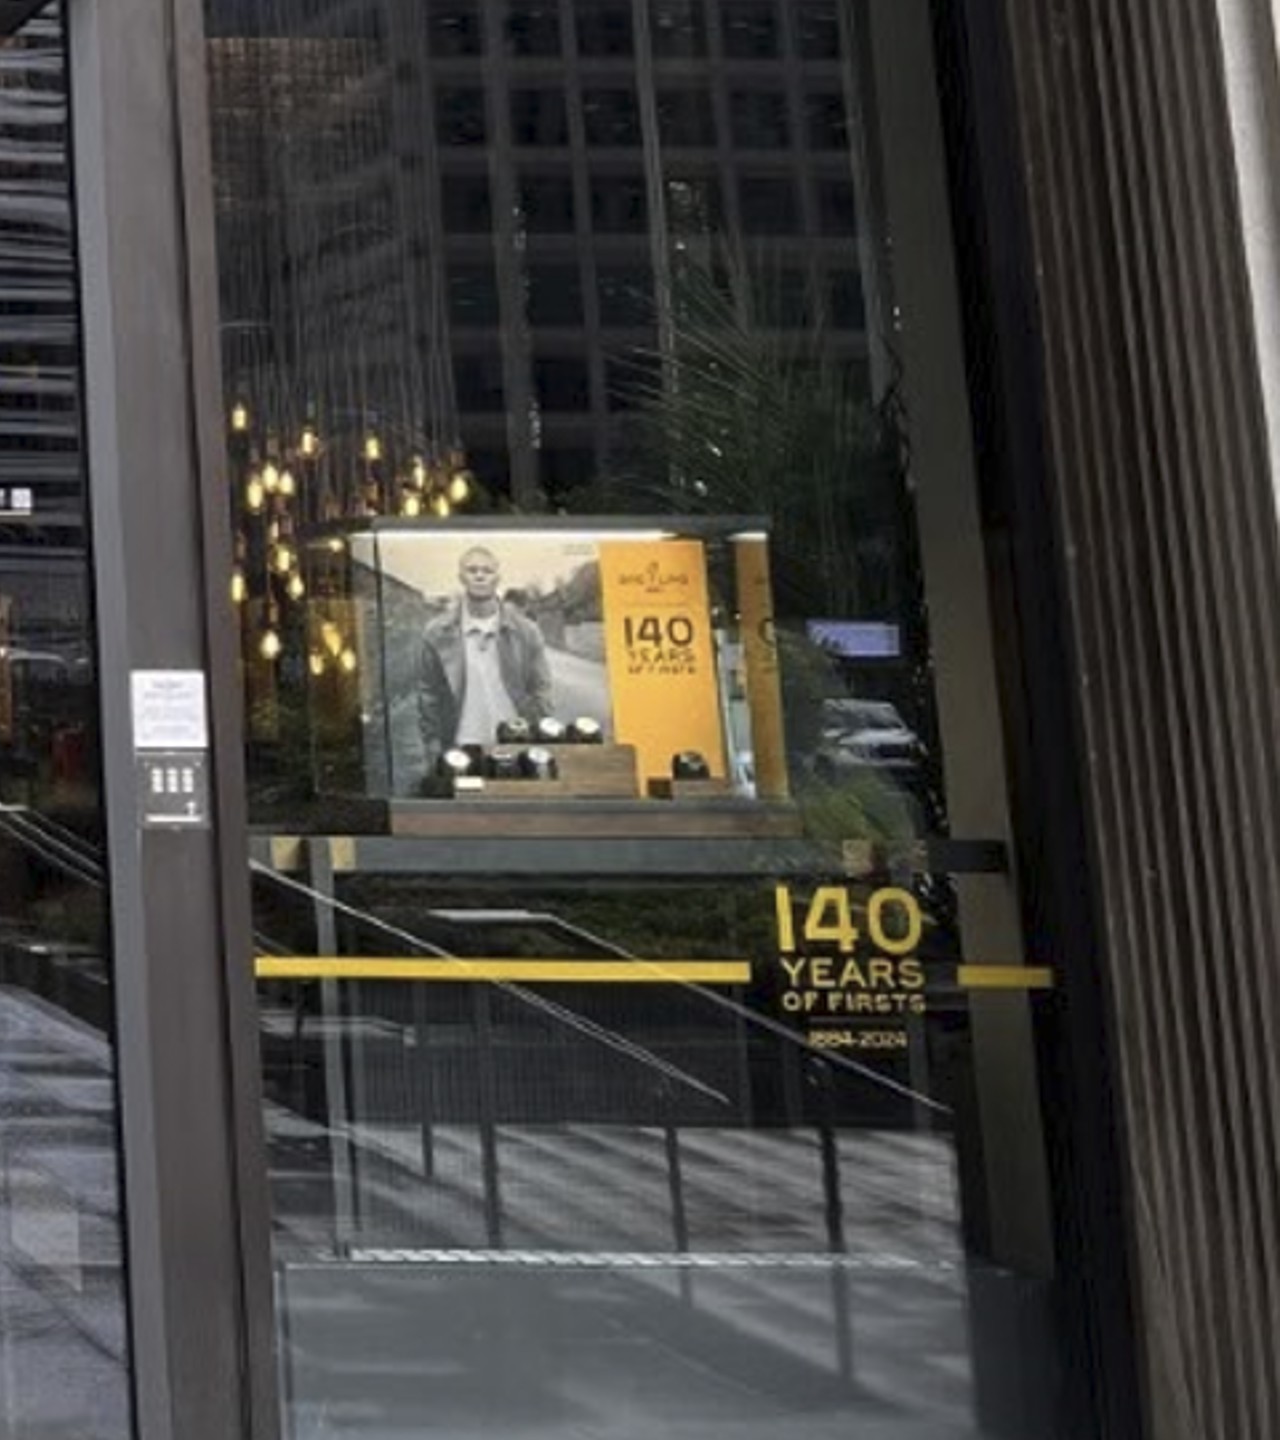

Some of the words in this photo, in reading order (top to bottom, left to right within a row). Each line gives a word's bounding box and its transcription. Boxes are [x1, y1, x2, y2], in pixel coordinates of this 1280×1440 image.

[624, 616, 693, 648] 140
[628, 648, 695, 663] YEARS
[775, 883, 923, 955] 140
[779, 957, 925, 988] YEARS
[783, 991, 818, 1012] OF
[827, 991, 926, 1014] FIRSTS
